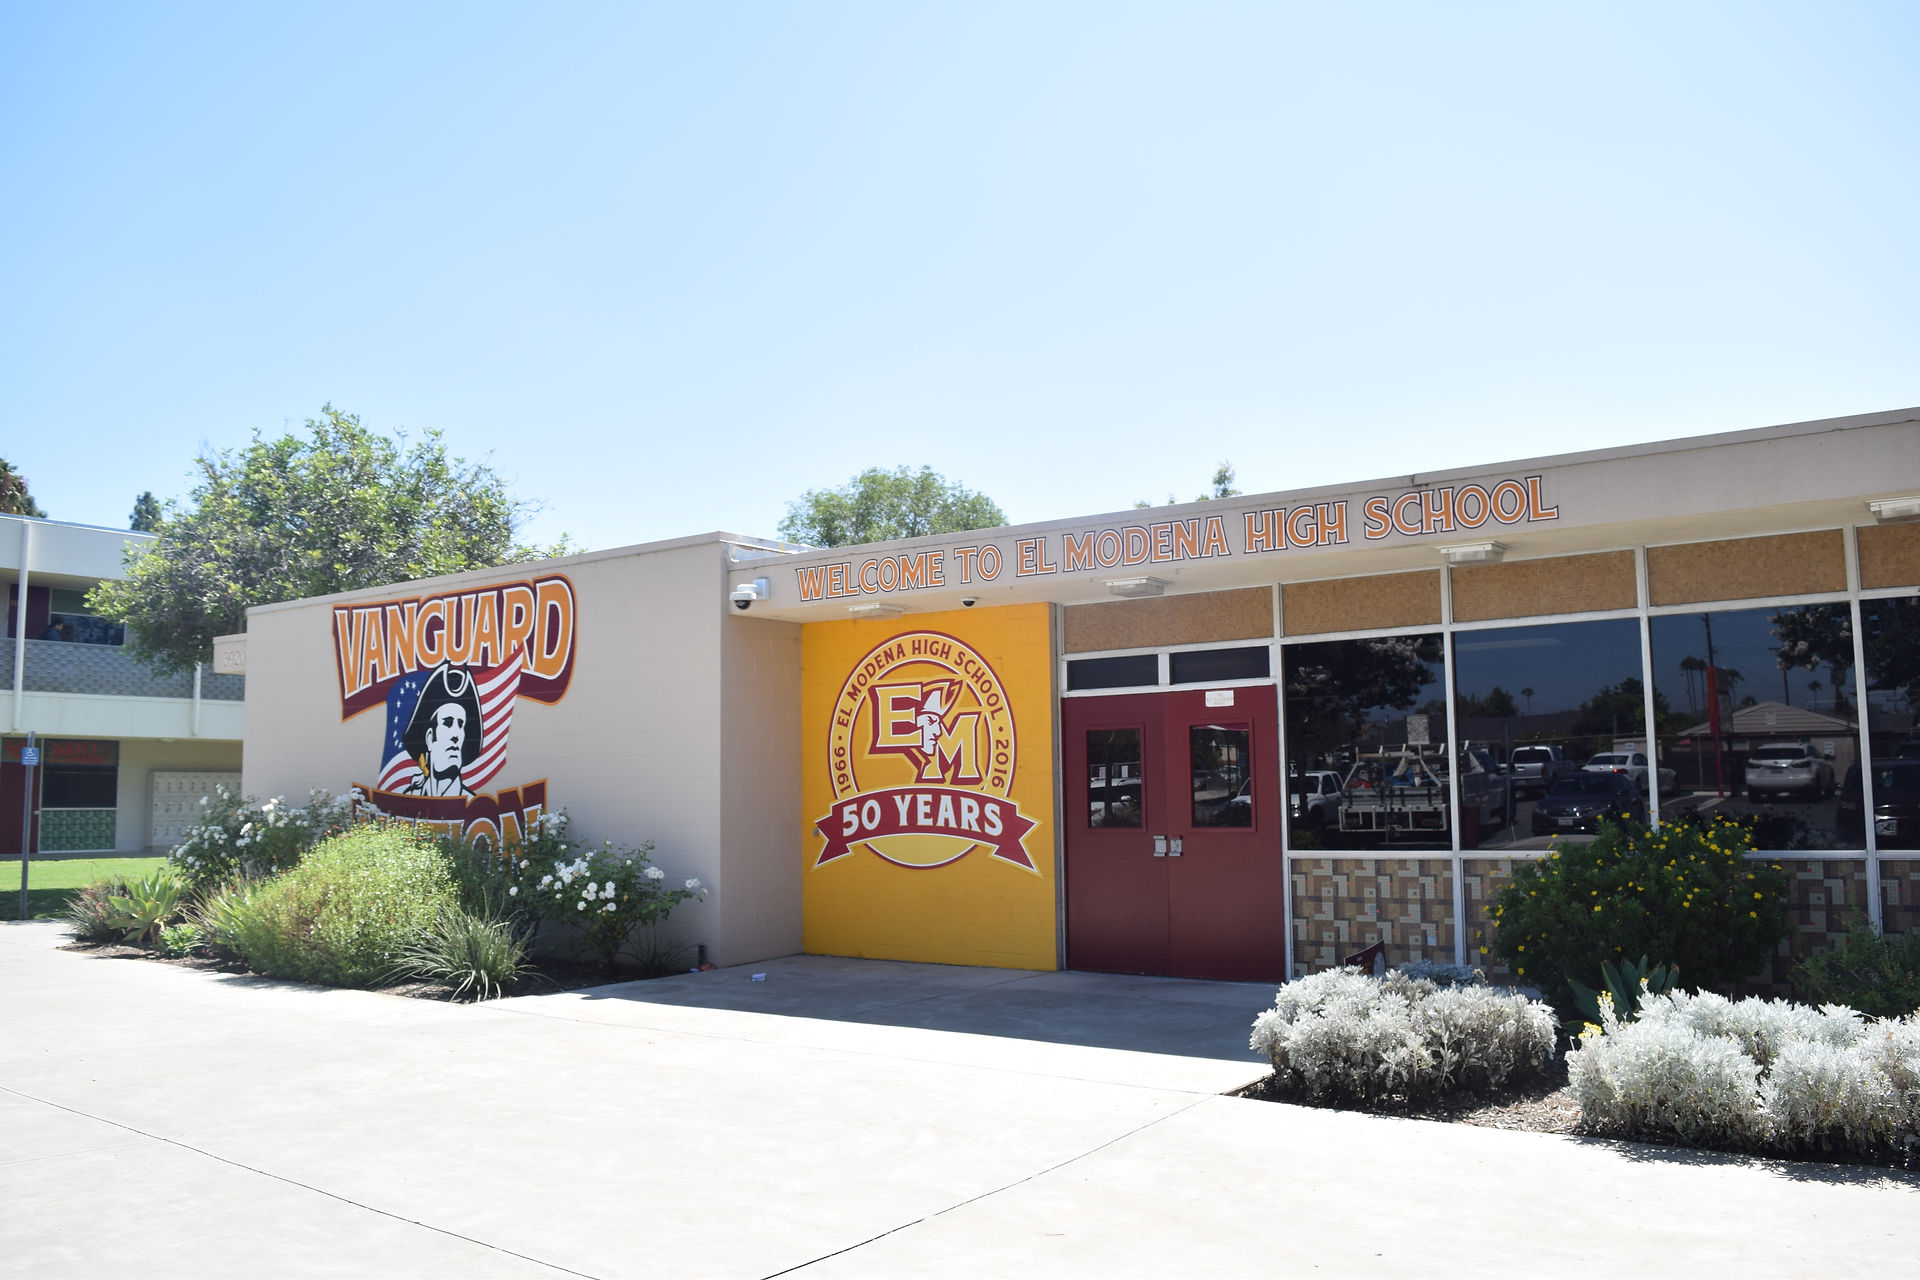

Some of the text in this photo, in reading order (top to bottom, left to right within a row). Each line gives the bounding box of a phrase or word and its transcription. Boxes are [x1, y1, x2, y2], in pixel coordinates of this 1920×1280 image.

[796, 475, 1559, 602] WELCOME TO EL MODENA HIGH SCHOOL
[334, 579, 574, 700] VANGUARD
[837, 639, 1004, 728] EL MODENA HIGH SCHOOL
[834, 746, 851, 794] 1966
[991, 739, 1009, 789] 2016
[842, 794, 1004, 837] 50 YEARS
